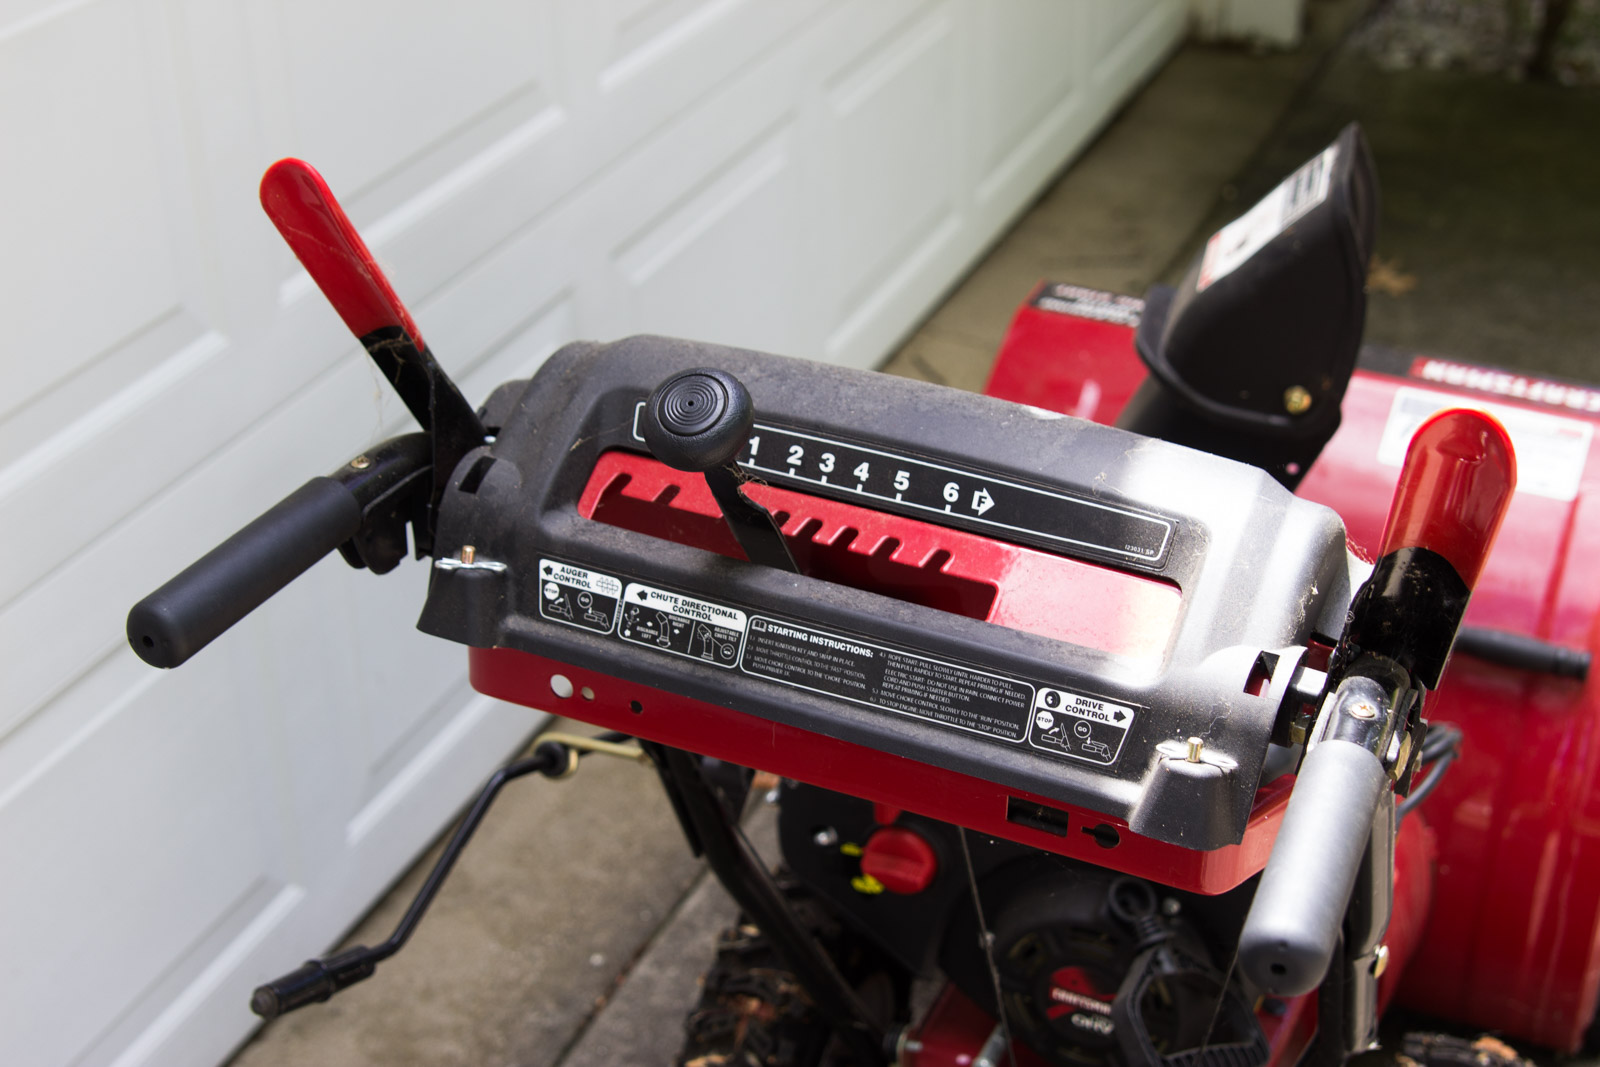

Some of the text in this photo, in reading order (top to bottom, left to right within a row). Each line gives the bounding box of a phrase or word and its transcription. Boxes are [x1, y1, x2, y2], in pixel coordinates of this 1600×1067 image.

[749, 436, 988, 508] 1 2 3 4 5 6 F
[553, 572, 591, 588] CONTROL
[560, 566, 588, 579] AUGER
[650, 591, 738, 620] CHUTE DIRECTIONAL
[672, 604, 712, 621] CONTROL
[668, 614, 690, 624] DISCHARGE
[636, 625, 658, 635] DISCHARGE
[714, 626, 739, 637] ADJUSTABLE
[757, 637, 774, 646] INSERT
[775, 641, 796, 652] IGNITION
[806, 649, 818, 657] AND
[819, 652, 832, 661] SNAP
[767, 624, 873, 658] STARTING INSTRUCTIONS:
[753, 655, 767, 664] MOVE
[767, 659, 783, 668] CHOKE
[784, 663, 806, 674] CONTROL
[755, 646, 768, 654] MOVE
[769, 650, 790, 660] THROTTLE
[791, 655, 813, 666] CONTROL
[752, 662, 765, 670] PUSH
[887, 653, 901, 661] ROPE
[919, 661, 931, 669] PULL
[932, 664, 952, 674] SLOWLY
[953, 669, 968, 678] UNTIL
[969, 674, 990, 684] HARDER
[883, 675, 898, 683] CORD
[911, 682, 925, 690] PUSH
[925, 685, 947, 696] STARTER
[886, 660, 900, 668] THEN
[900, 663, 912, 671] PULL
[913, 666, 933, 676] RAPIDLY
[958, 678, 976, 687] REPEAT
[977, 682, 998, 693] PRIMING
[882, 681, 900, 691] REPEAT
[901, 686, 922, 697] PRIMING
[884, 668, 907, 679] ELECTRIC
[935, 681, 947, 689] NOT
[979, 692, 1004, 703] CONNECT
[1005, 699, 1024, 709] POWER
[880, 689, 895, 698] MOVE
[896, 693, 915, 703] CHOKE
[914, 698, 938, 709] CONTROL
[939, 704, 959, 715] SLOWLY
[886, 699, 899, 708] STOP
[918, 708, 932, 716] MOVE
[933, 712, 958, 723] THROTTLE
[1075, 697, 1104, 711] DRIVE
[1037, 715, 1052, 723] STOP
[1065, 704, 1110, 721] CONTROL
